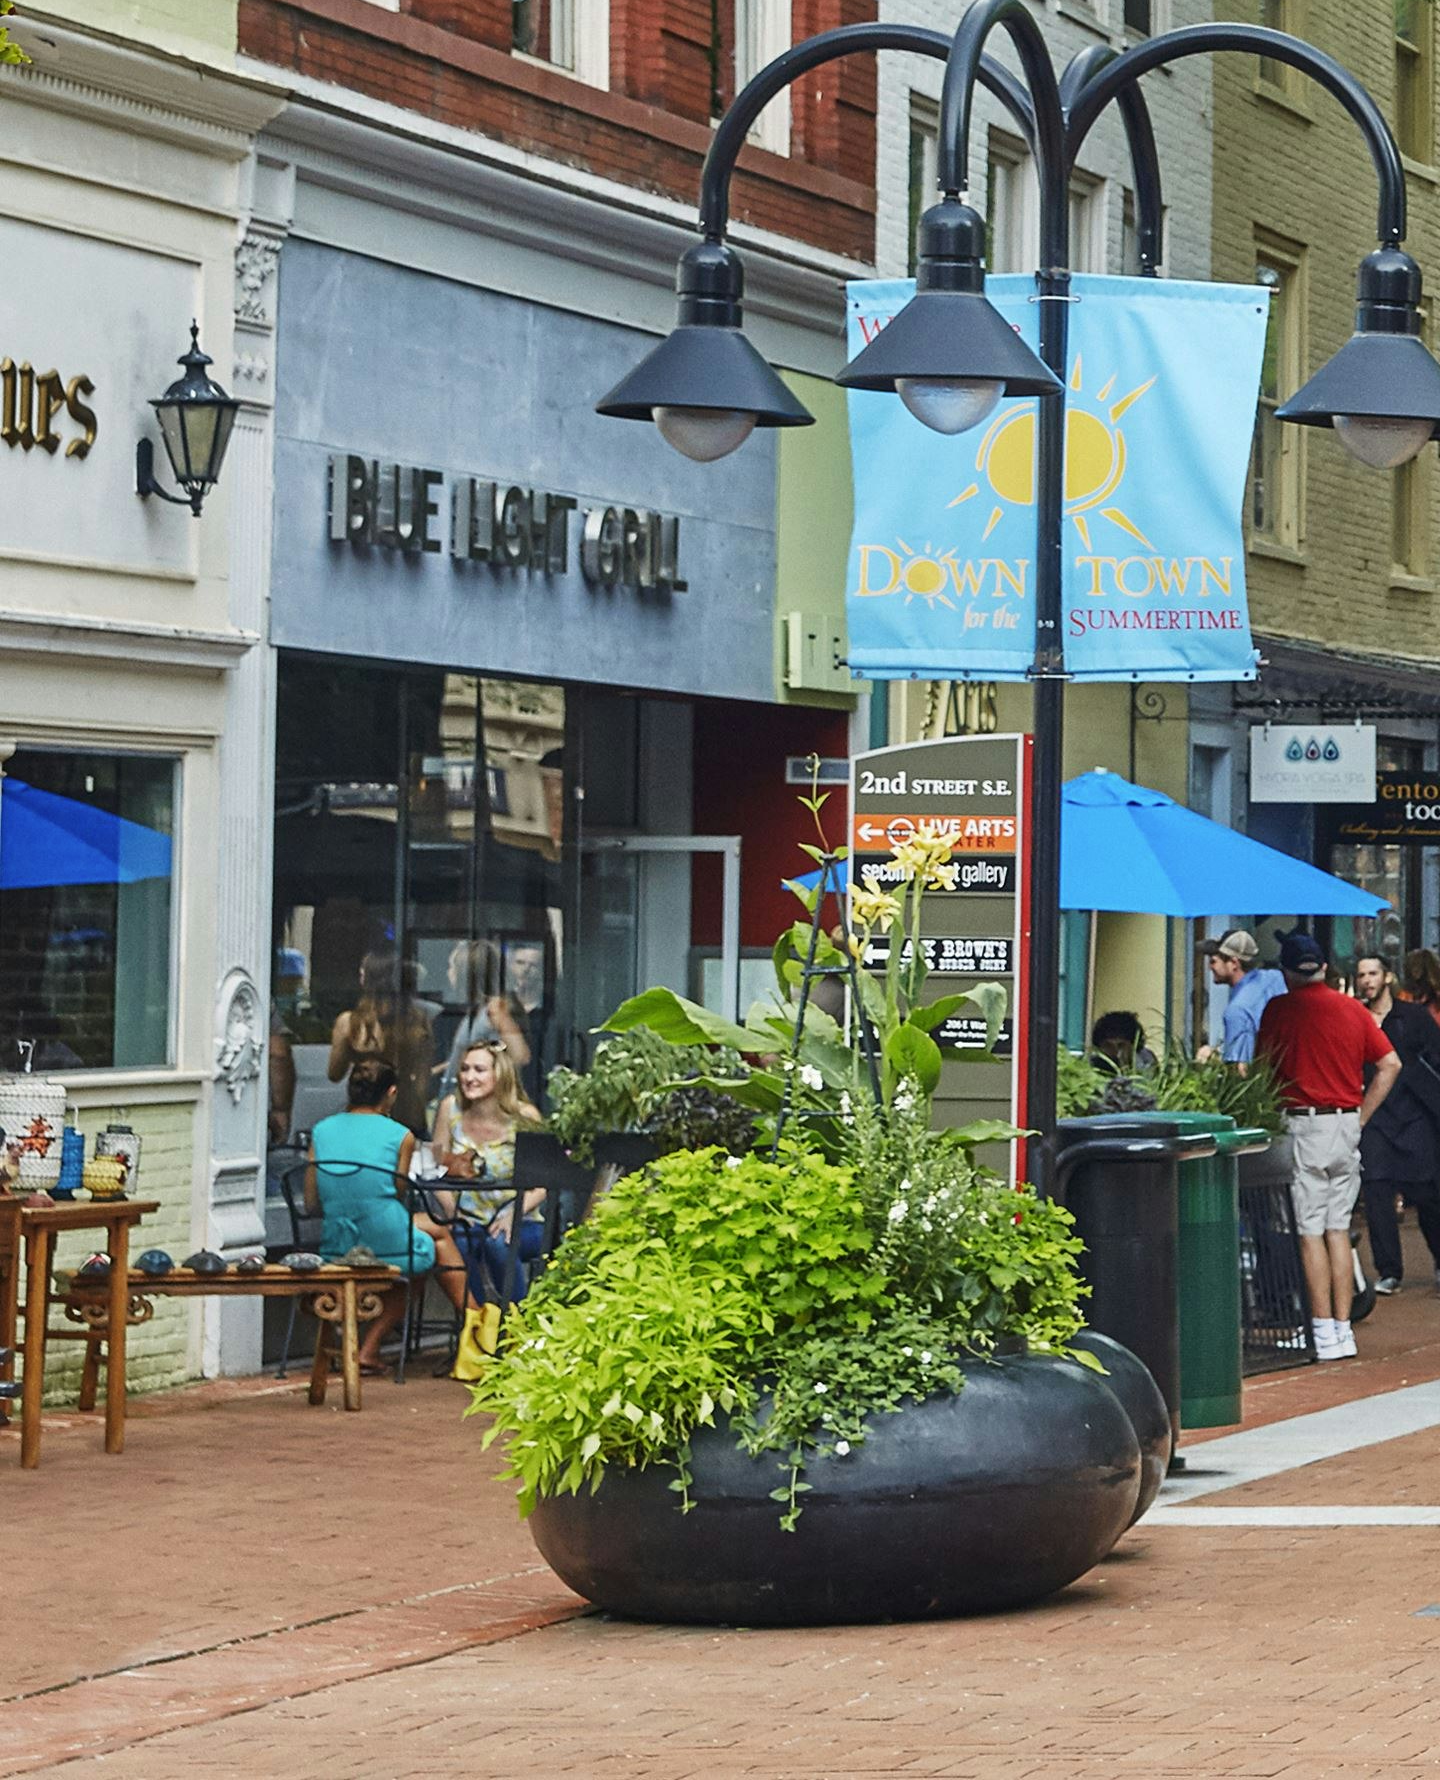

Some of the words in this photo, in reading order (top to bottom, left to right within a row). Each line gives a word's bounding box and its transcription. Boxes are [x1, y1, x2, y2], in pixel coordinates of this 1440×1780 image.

[328, 454, 444, 553] BLUE
[450, 477, 577, 574] LIGHT
[581, 505, 688, 593] GRILL
[1074, 554, 1232, 599] TOWN
[959, 601, 987, 637] for
[992, 603, 1021, 630] the
[1069, 608, 1244, 637] SUMMERTIME
[859, 771, 907, 795] 2nd
[911, 778, 978, 796] STREET
[981, 780, 1012, 796] S.E.
[964, 819, 1015, 837] ARTS
[961, 861, 1008, 888] gallery
[942, 940, 1007, 958] BROWN'S
